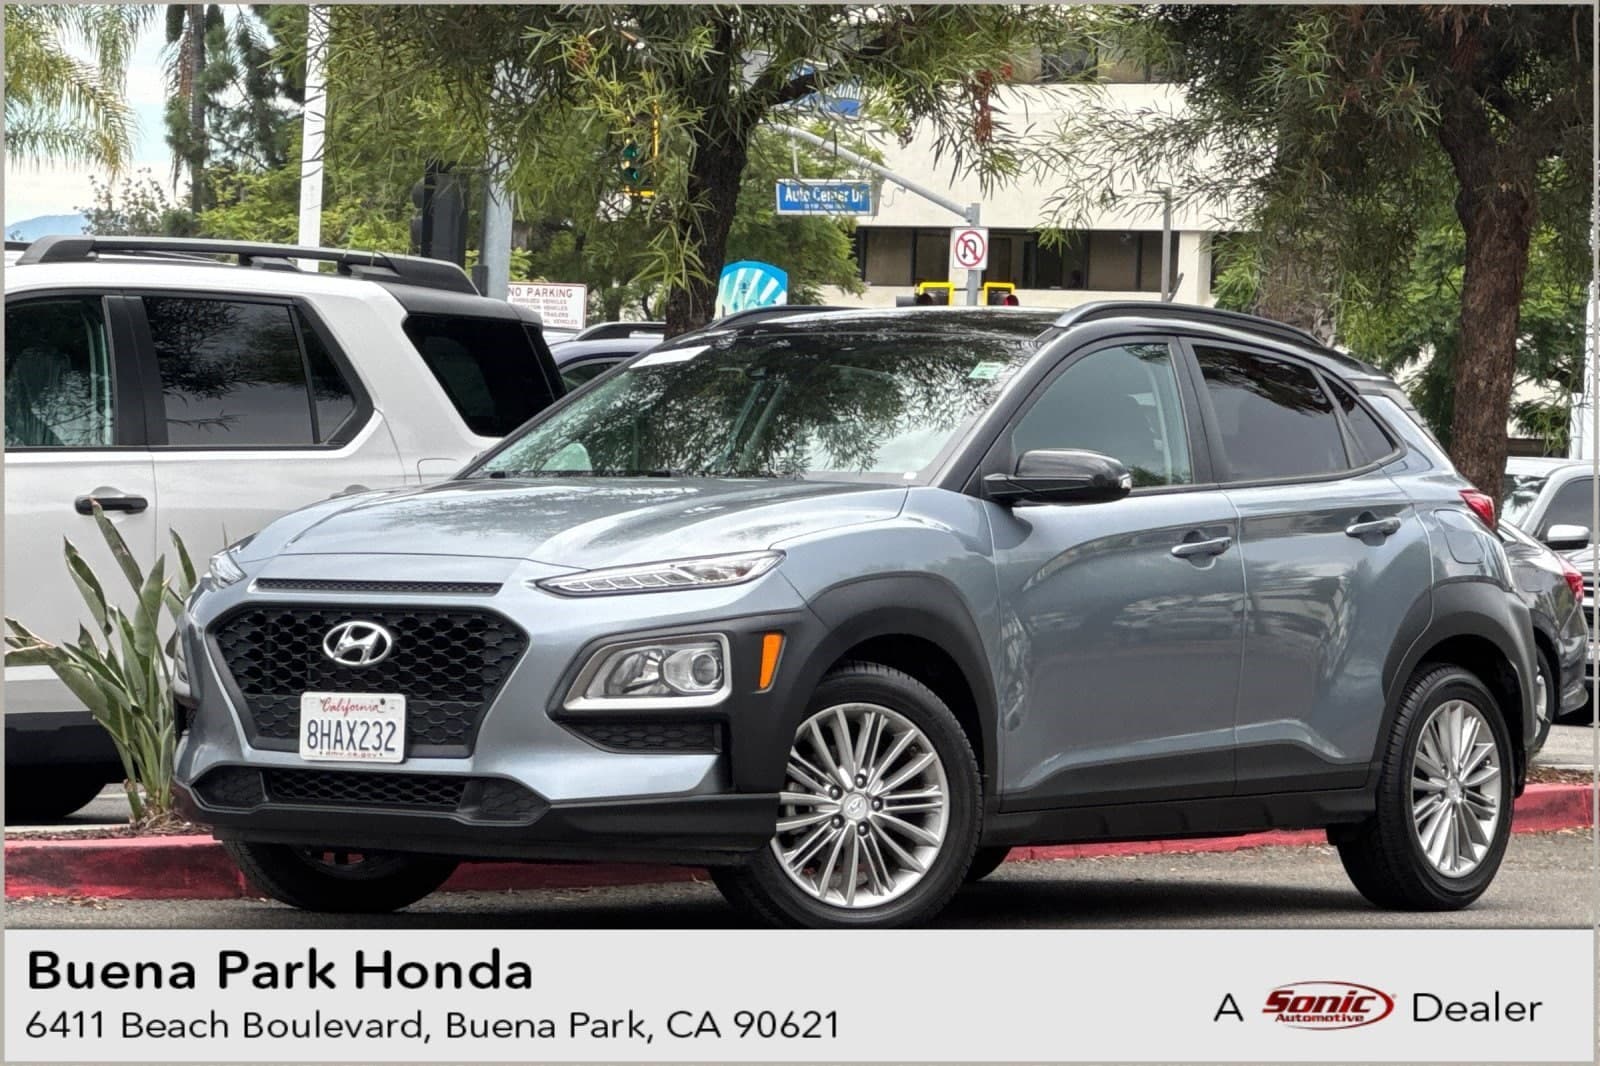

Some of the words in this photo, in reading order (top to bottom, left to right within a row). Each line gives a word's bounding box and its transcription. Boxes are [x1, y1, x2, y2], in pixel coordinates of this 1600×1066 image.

[785, 186, 810, 202] Auto
[508, 287, 522, 296] NO
[527, 287, 573, 298] PARKING
[320, 697, 385, 717] California
[307, 719, 397, 752] 8HAX232
